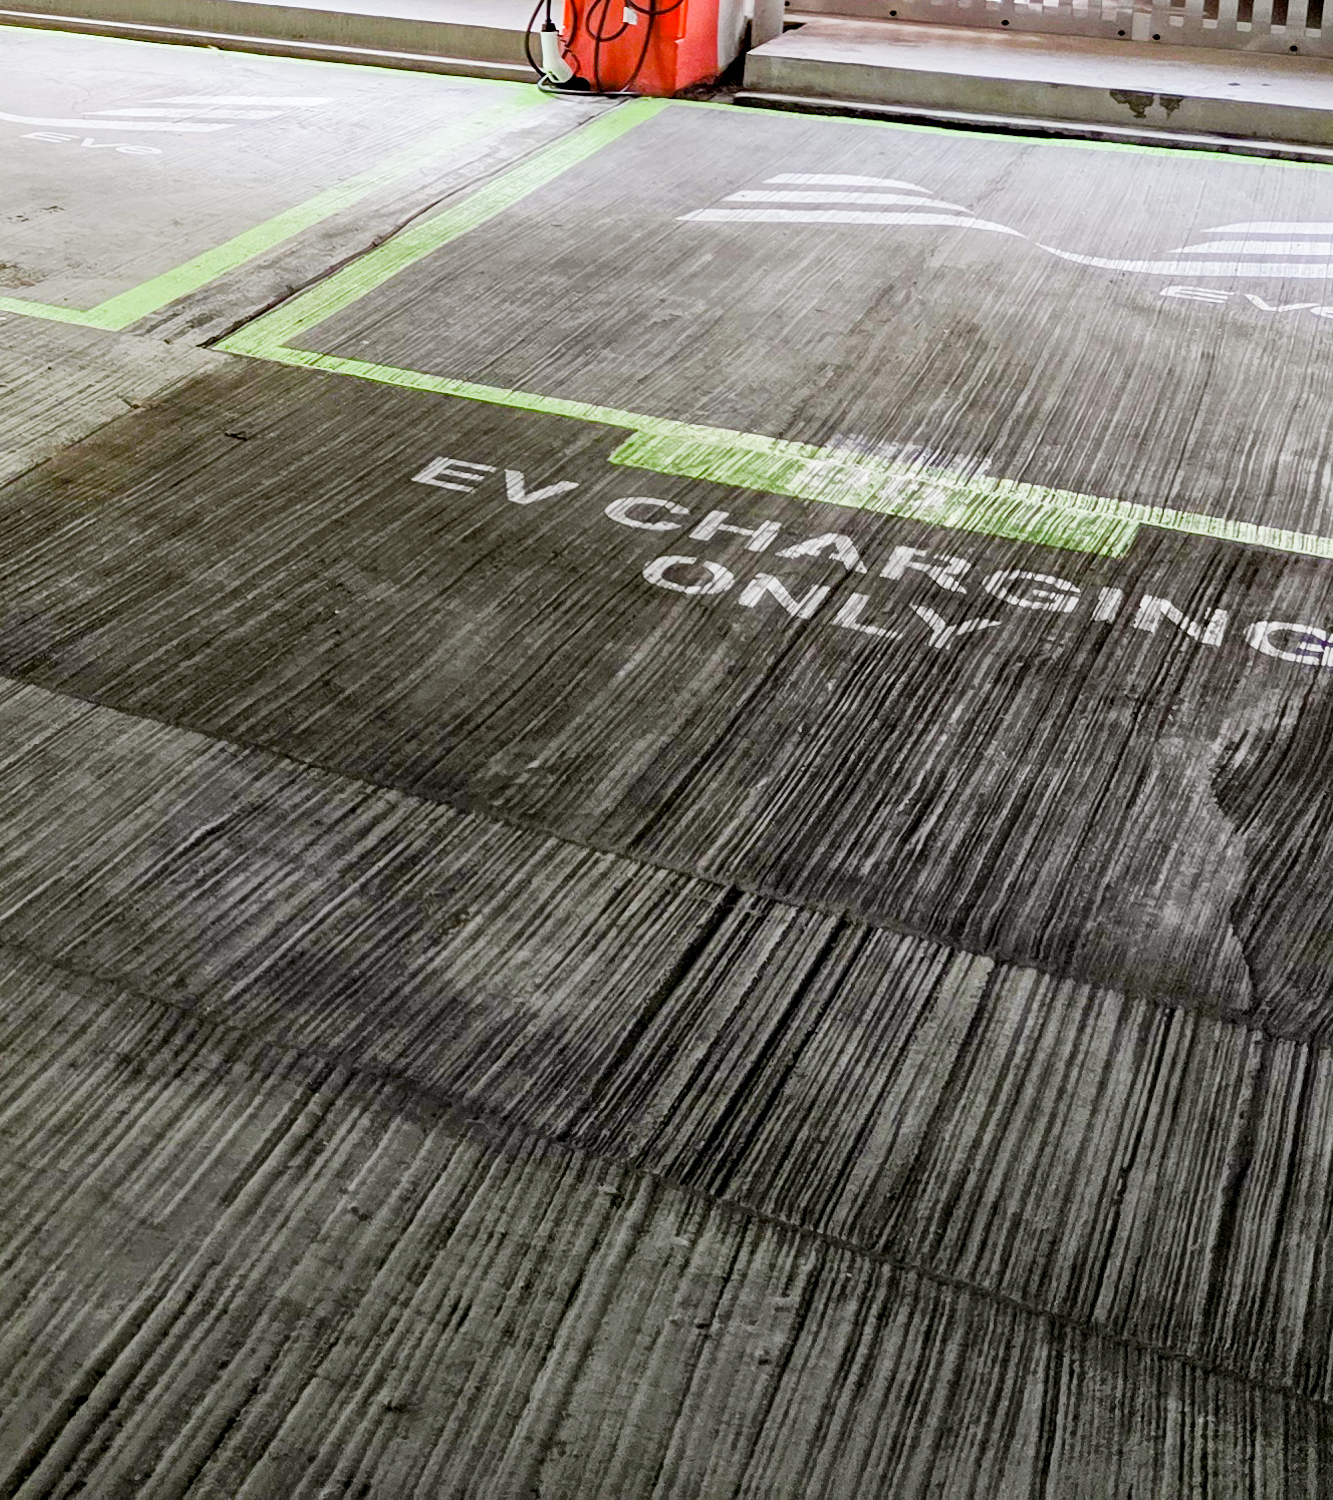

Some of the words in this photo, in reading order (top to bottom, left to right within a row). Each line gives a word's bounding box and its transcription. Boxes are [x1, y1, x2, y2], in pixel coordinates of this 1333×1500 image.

[411, 456, 579, 505] EV
[604, 495, 1333, 668] CHARGING
[641, 554, 1002, 651] ONLY
